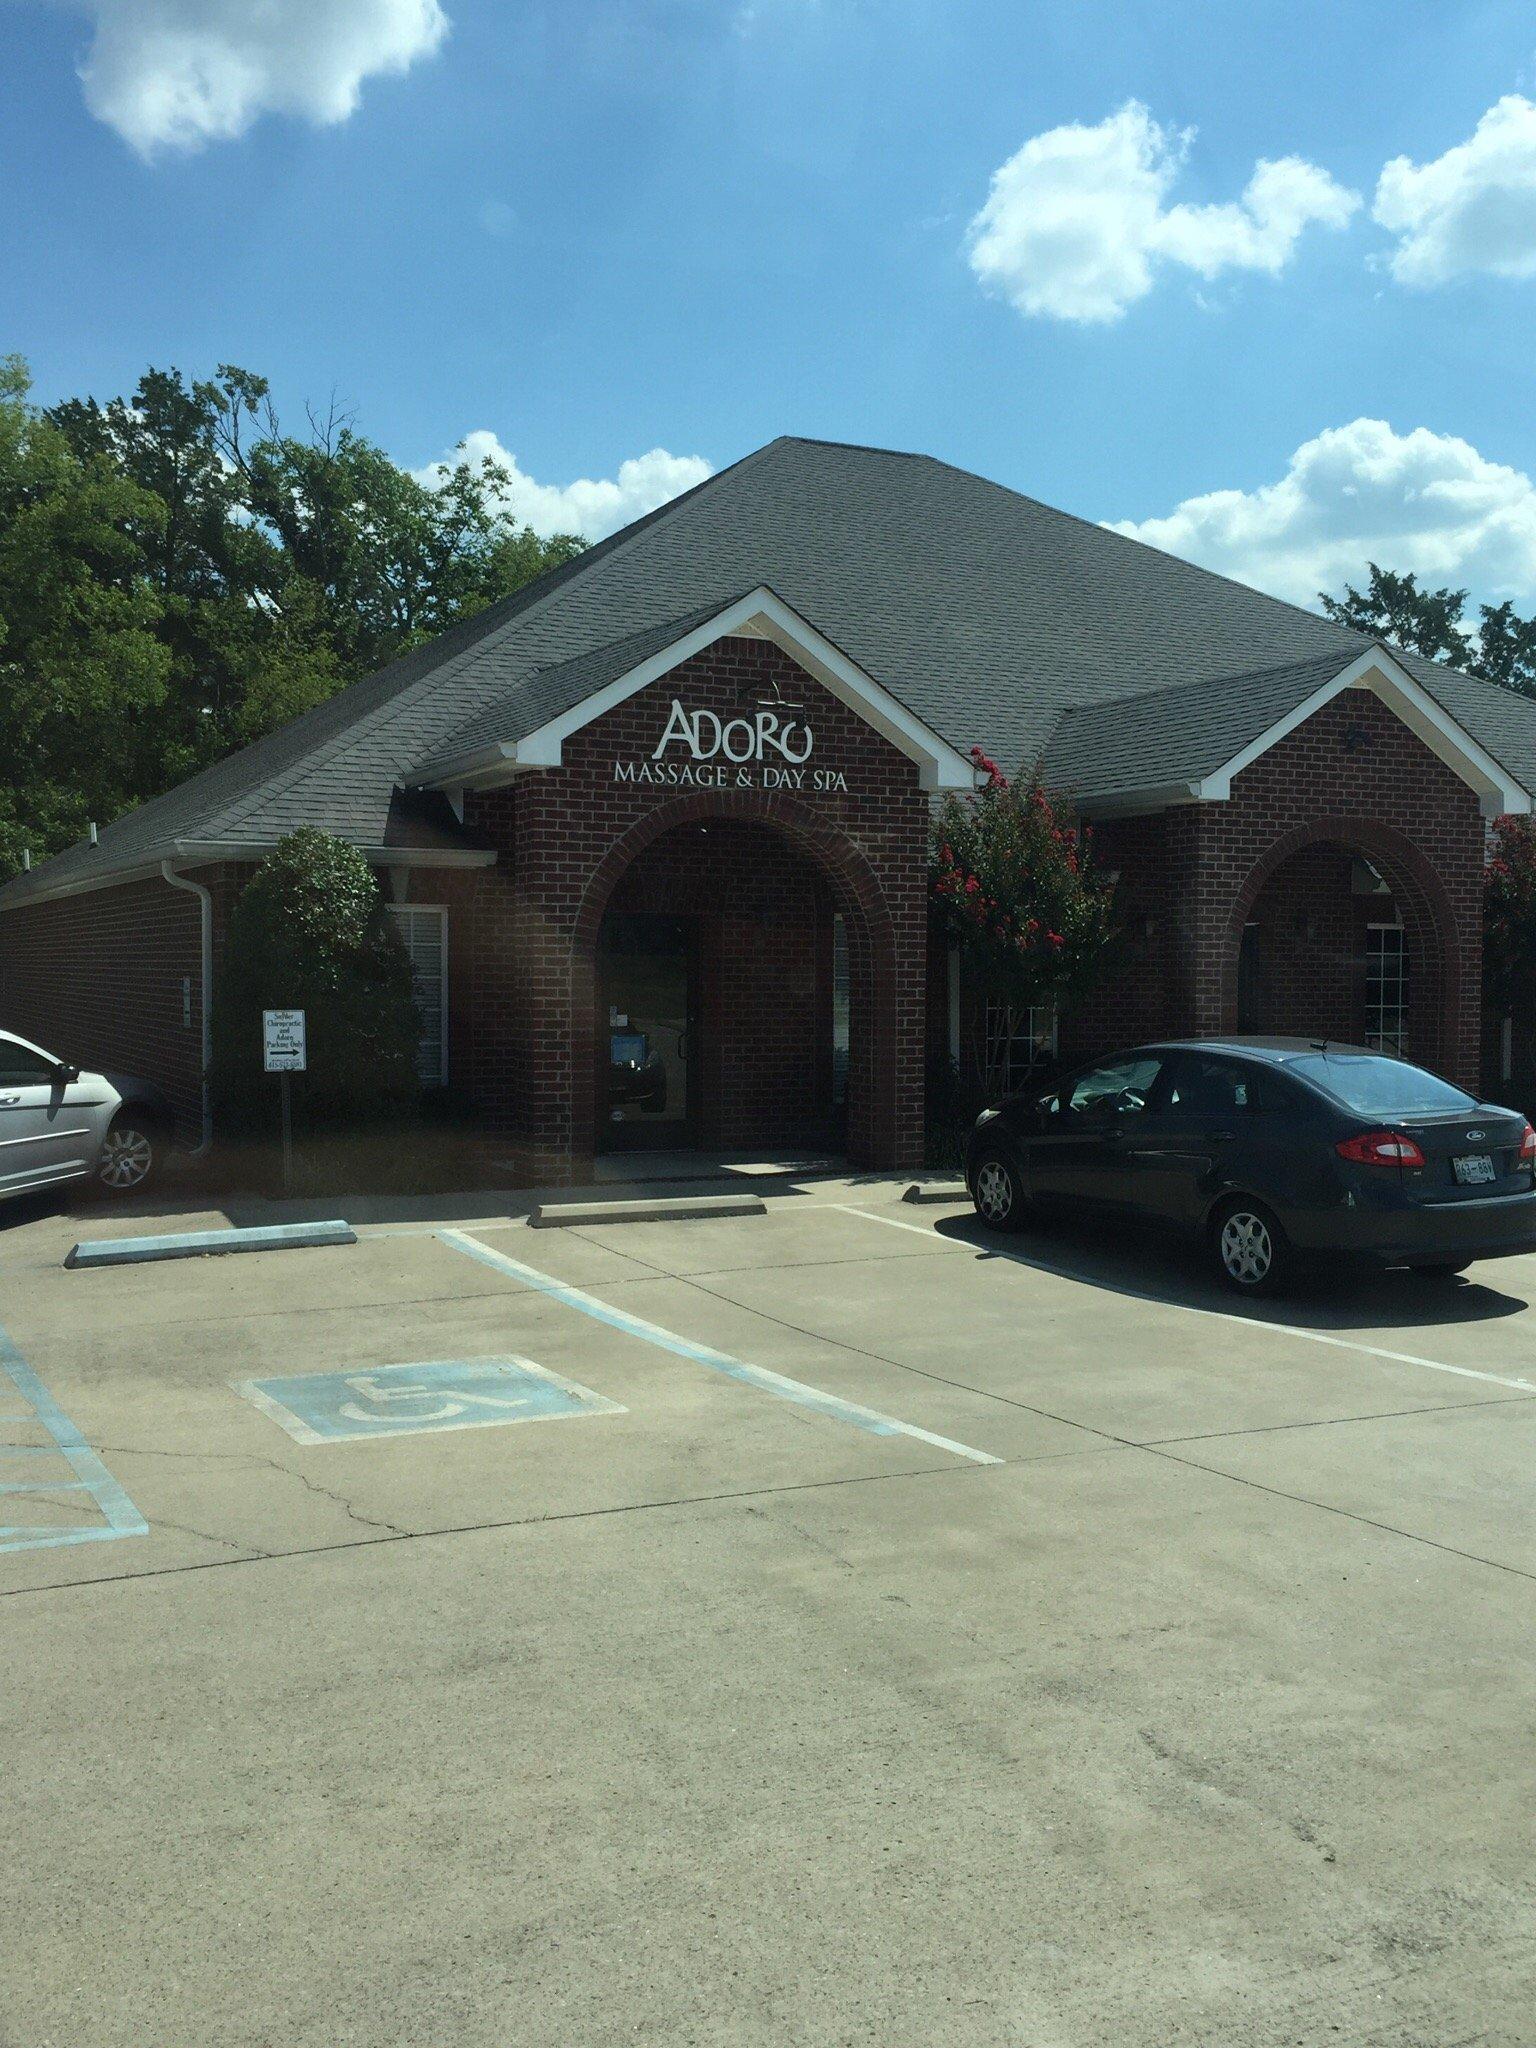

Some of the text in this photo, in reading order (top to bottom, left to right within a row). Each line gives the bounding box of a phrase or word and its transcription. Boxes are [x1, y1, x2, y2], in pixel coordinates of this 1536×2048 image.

[614, 761, 849, 792] MASSAGE & DAY SPA
[267, 1019, 302, 1028] Chiropractic
[267, 1040, 303, 1048] Parking Only
